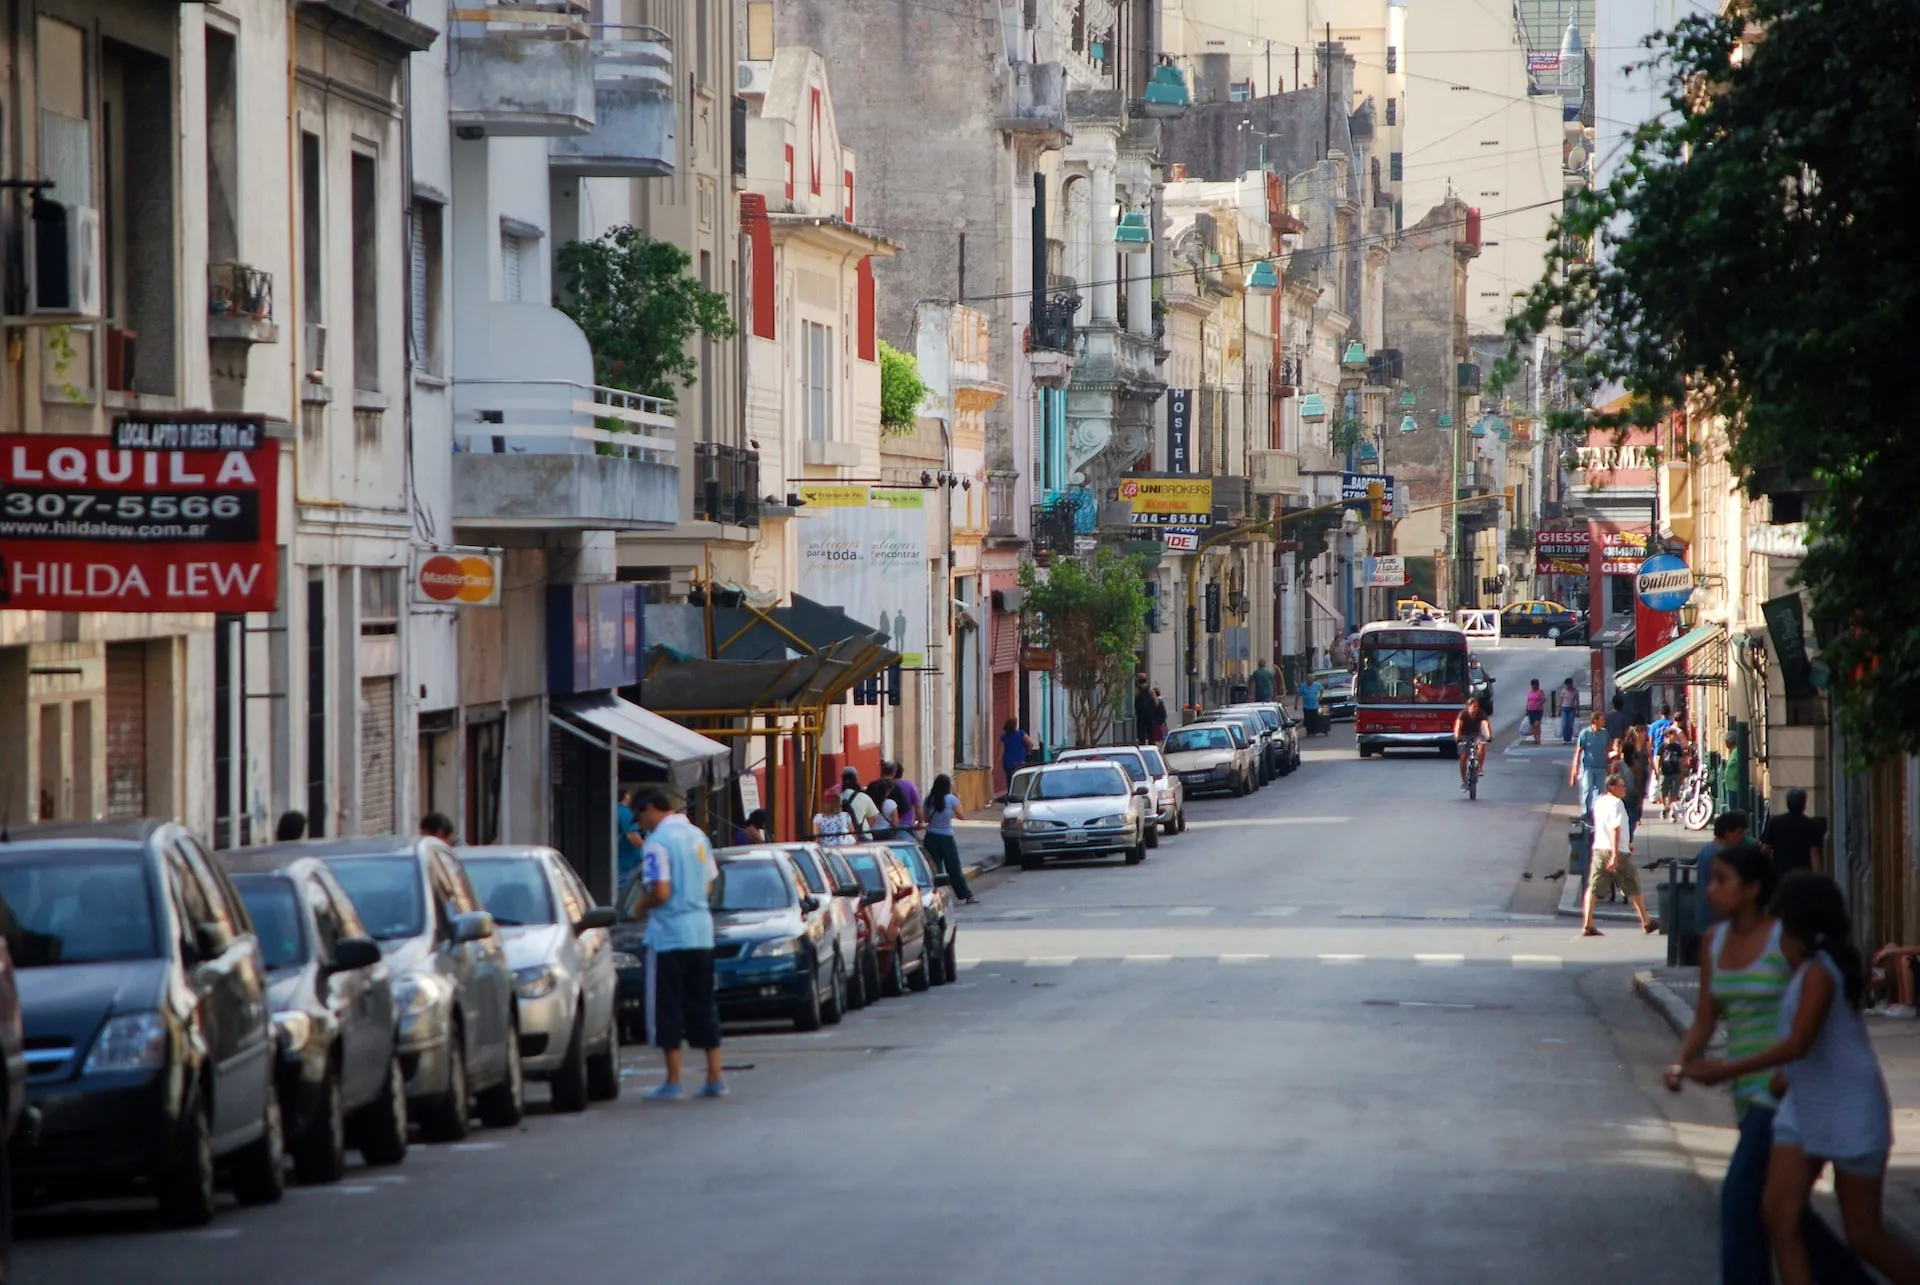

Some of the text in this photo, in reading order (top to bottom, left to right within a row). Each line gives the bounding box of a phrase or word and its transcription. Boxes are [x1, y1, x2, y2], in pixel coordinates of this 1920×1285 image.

[1174, 389, 1185, 474] HOSTEL
[12, 446, 257, 485] LQUILA
[1141, 484, 1210, 495] UNIBROKERS
[4, 492, 242, 519] 307-5566
[1132, 513, 1207, 524] 704-6544
[0, 521, 210, 537] www.hildalew.com.ar
[806, 549, 826, 558] para
[827, 548, 857, 561] toda
[875, 551, 920, 559] encontrar
[13, 561, 262, 598] HILDA LEW
[1640, 572, 1689, 592] Quilmes
